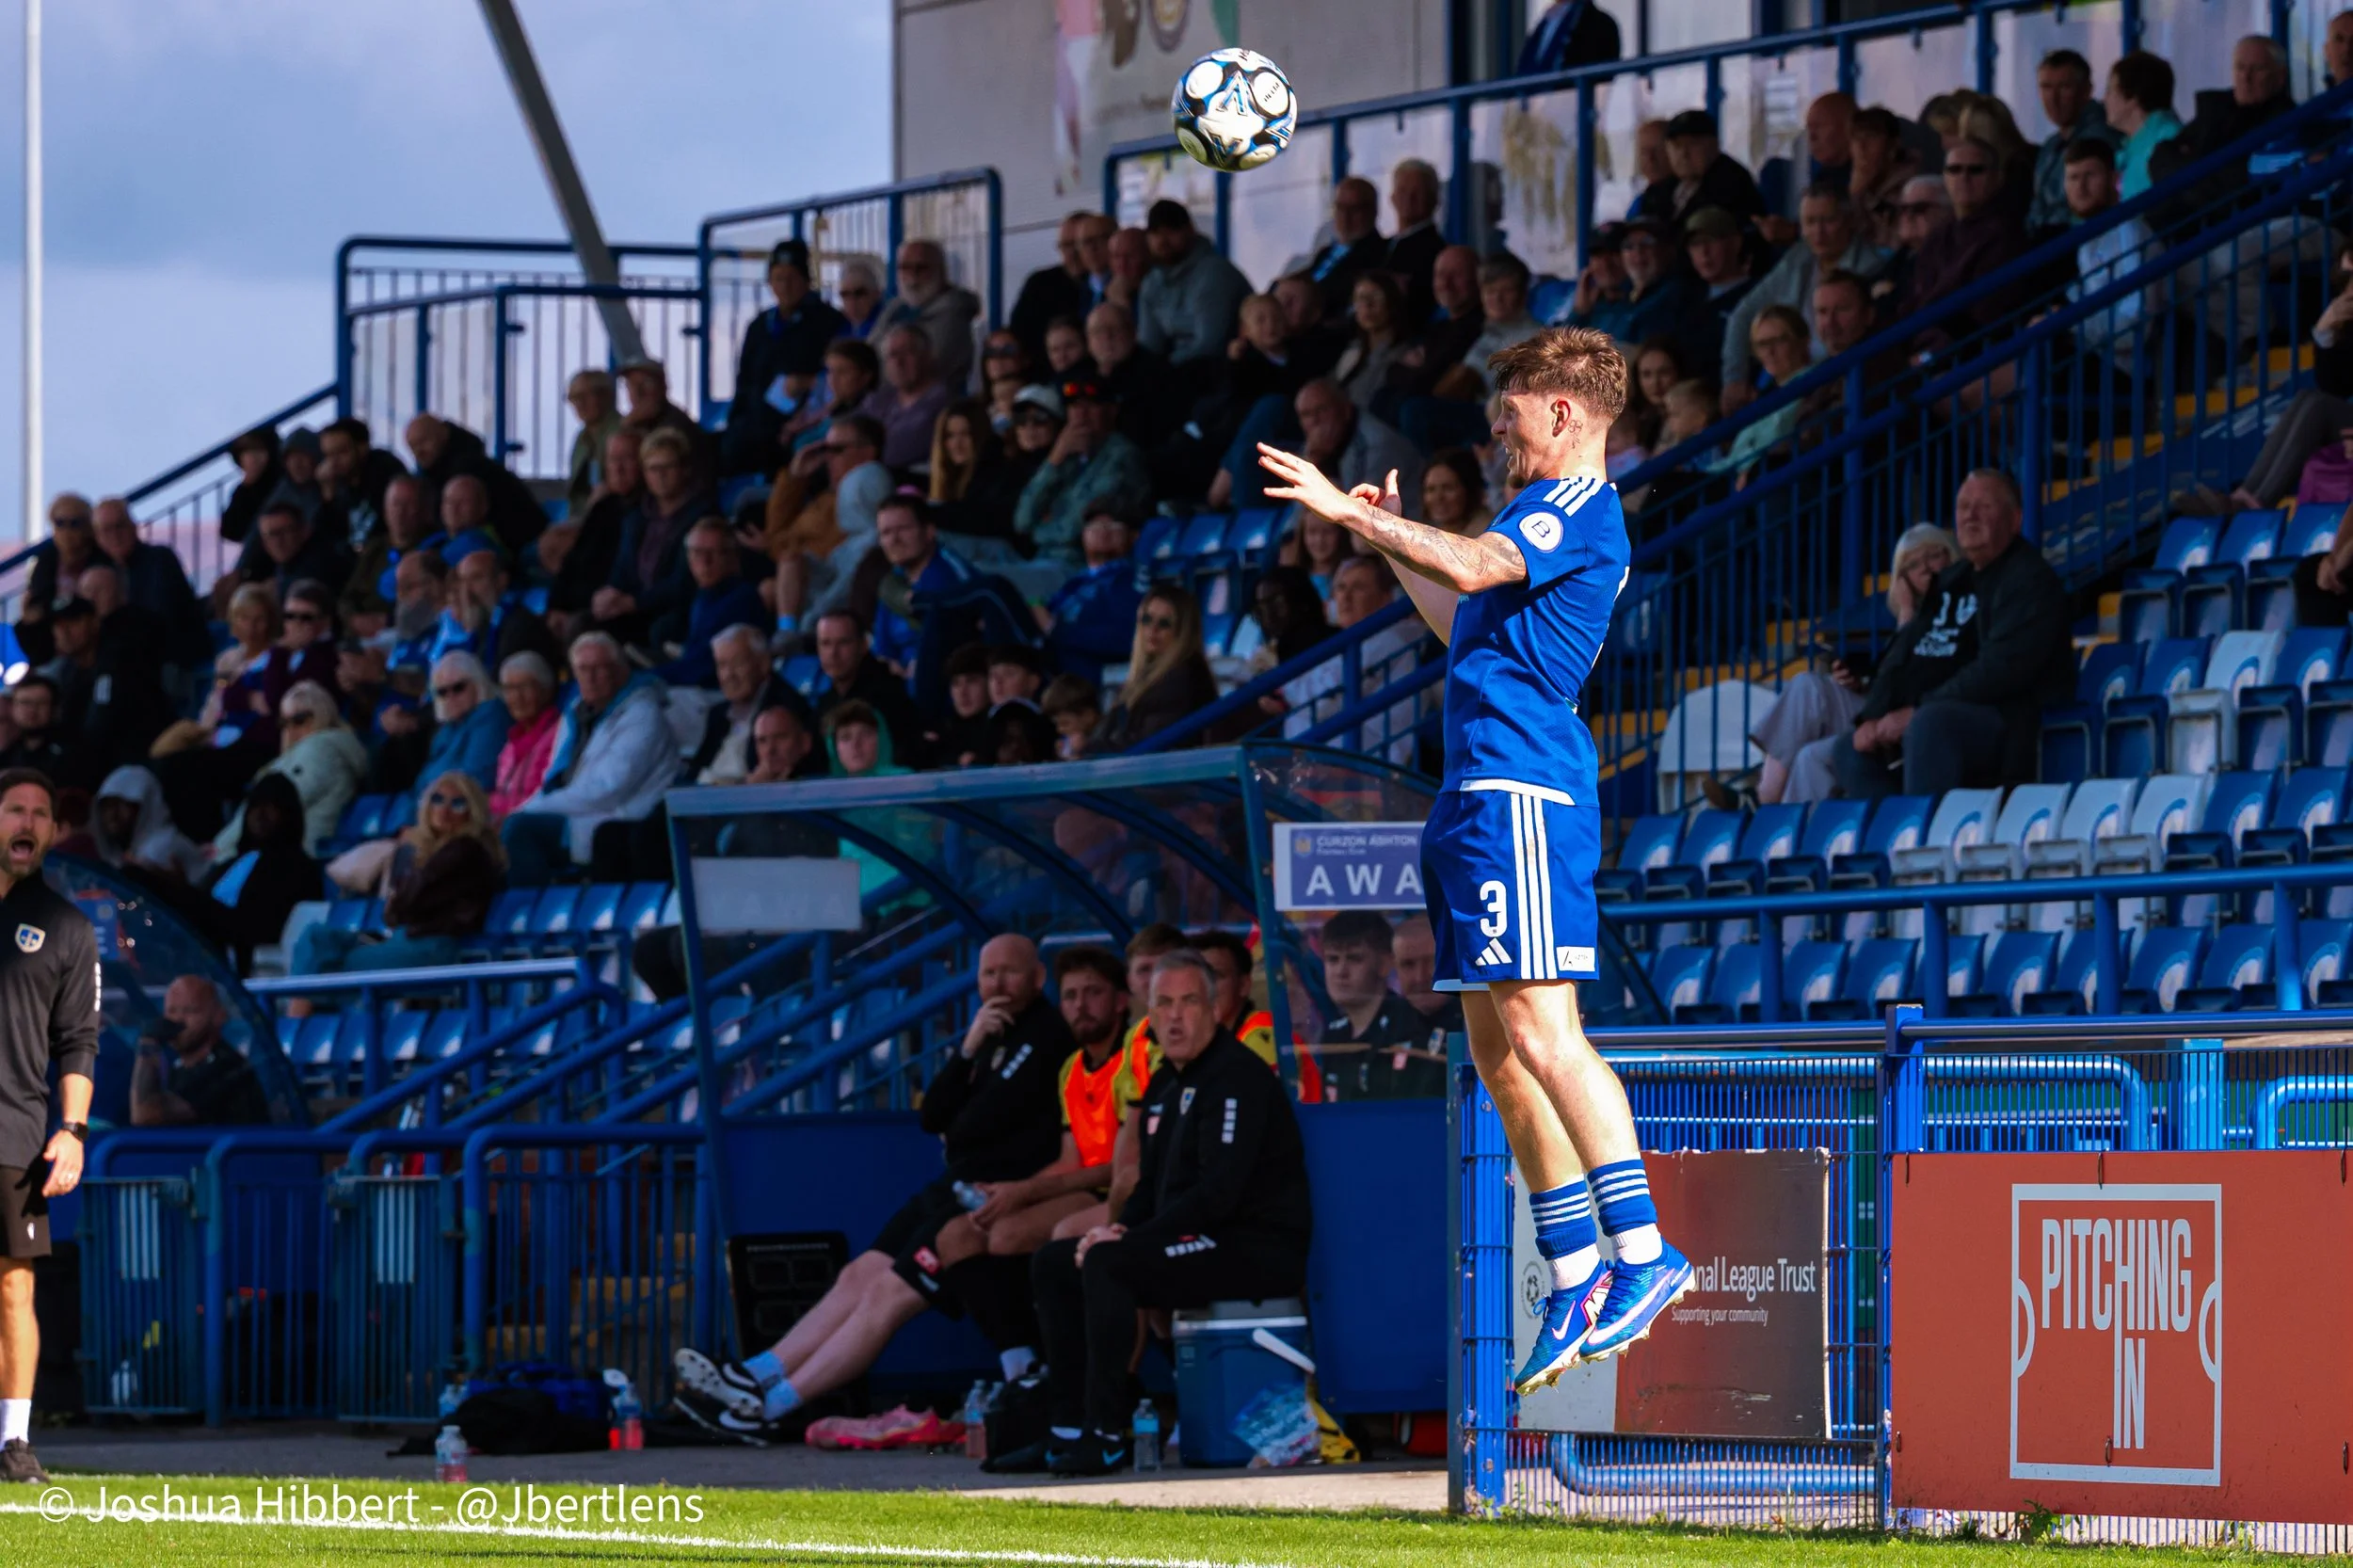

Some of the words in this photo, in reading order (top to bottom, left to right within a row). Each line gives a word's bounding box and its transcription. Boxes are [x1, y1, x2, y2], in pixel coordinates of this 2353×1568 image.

[1305, 863, 1423, 896] AWA
[1480, 880, 1508, 937] 3
[1696, 1256, 1719, 1292] nal
[1721, 1256, 1774, 1303] League
[1777, 1257, 1817, 1292] Trust
[2041, 1218, 2192, 1332] PITCHING
[1672, 1305, 1710, 1326] Supporting
[1710, 1309, 1728, 1326] your
[1728, 1305, 1769, 1326] community
[2113, 1337, 2146, 1449] IN
